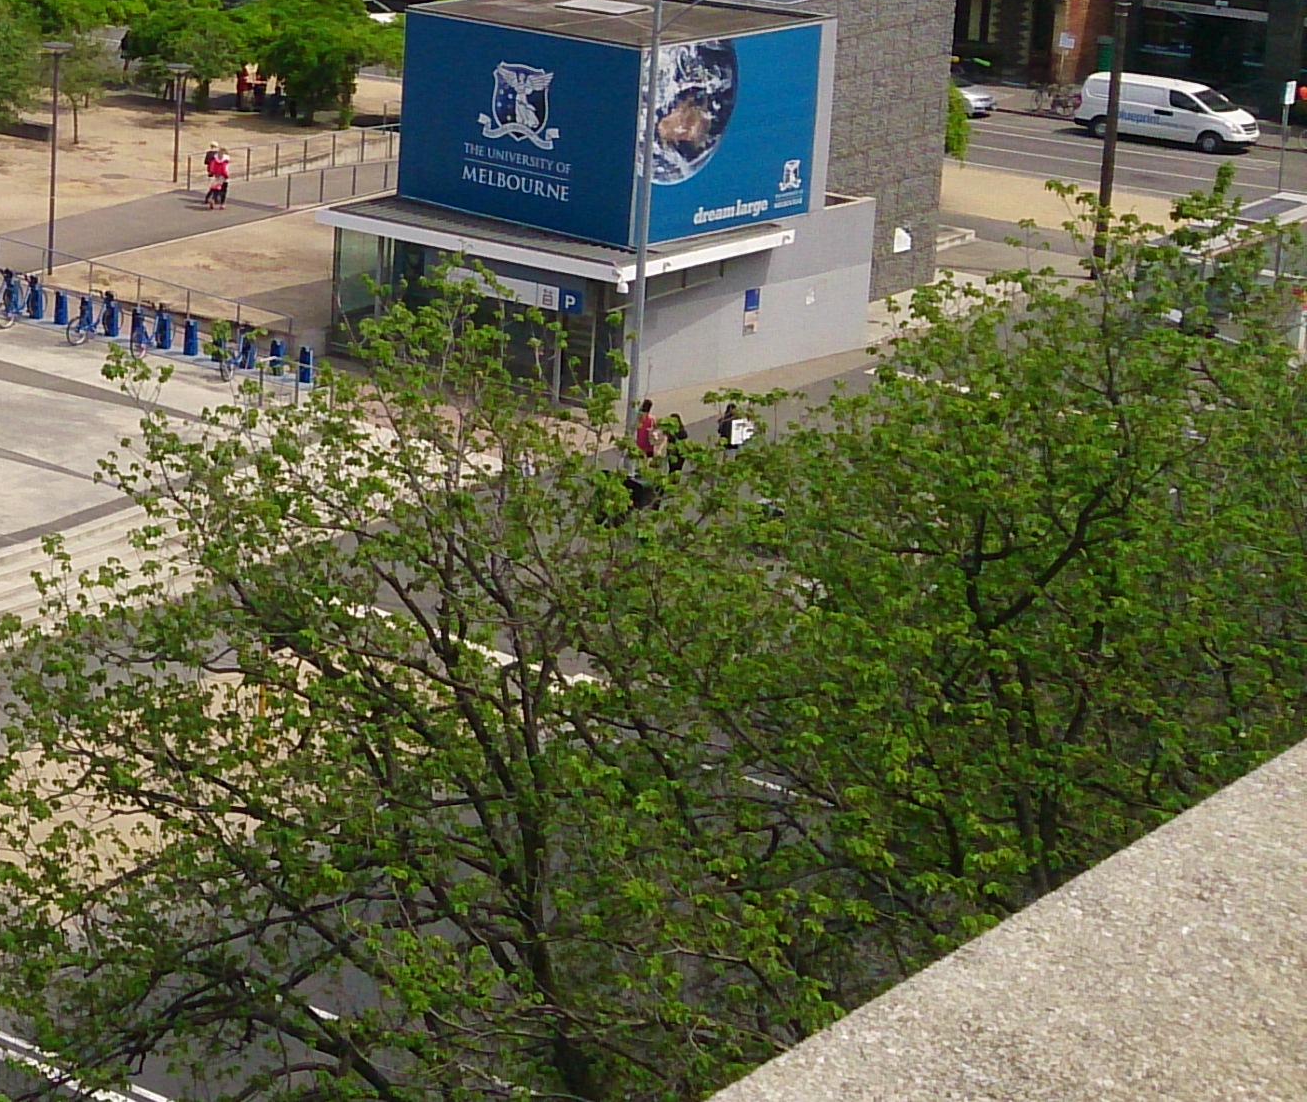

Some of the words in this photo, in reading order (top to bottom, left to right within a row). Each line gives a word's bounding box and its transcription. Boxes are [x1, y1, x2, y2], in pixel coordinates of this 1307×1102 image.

[463, 142, 484, 156] THE
[487, 147, 555, 171] UNIVERSITY
[555, 161, 572, 174] OF
[462, 164, 570, 202] MELBOURNE
[564, 294, 576, 309] P
